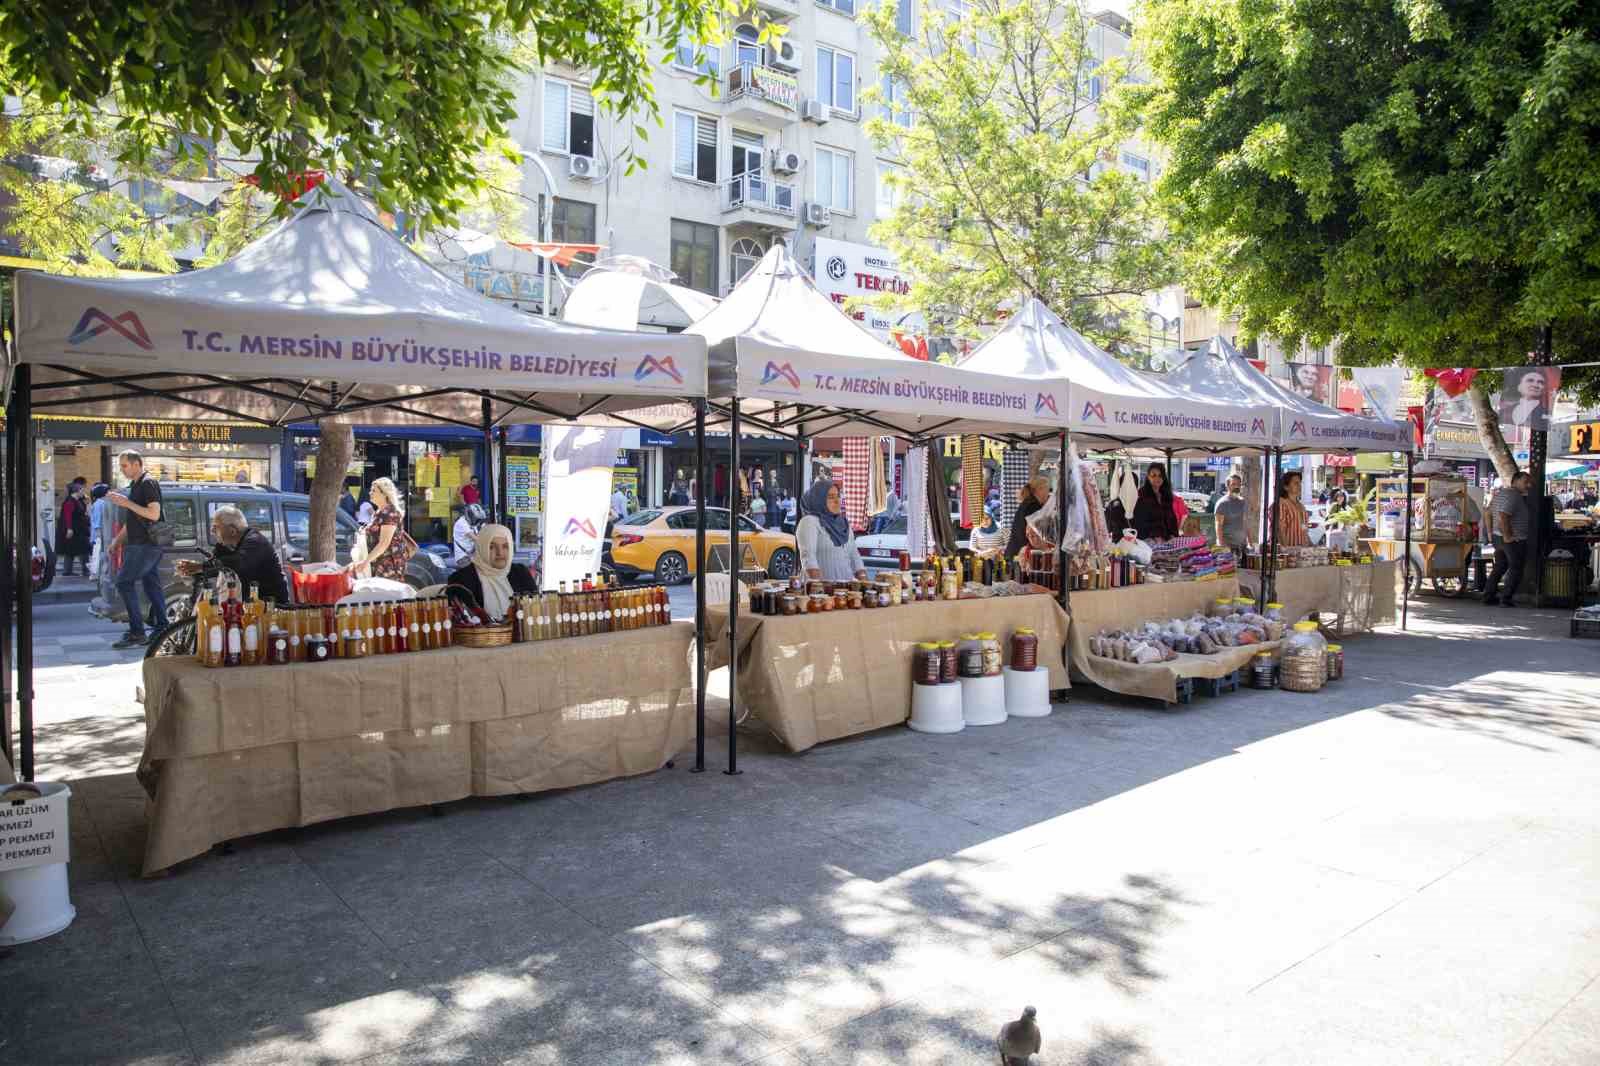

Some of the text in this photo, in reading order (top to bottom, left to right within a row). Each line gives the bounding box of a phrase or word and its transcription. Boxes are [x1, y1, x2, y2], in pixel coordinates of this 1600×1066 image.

[181, 329, 617, 378] T.C. MERSİN BÜYÜKŞEHİR BELEDİYESİ
[813, 374, 1027, 410] T.C. MERSİN BÜYÜKŞEHİR BELEDİYESİ
[1114, 410, 1247, 433] T.C. MERSİN BÜYÜKŞEHİR BELEDİYESİ
[104, 423, 232, 441] ALTIN ALINIR & SATILIR
[16, 803, 49, 817] ÜZÜM
[9, 829, 55, 845] PEKMEZİ
[6, 845, 52, 860] PEKMEZİ
